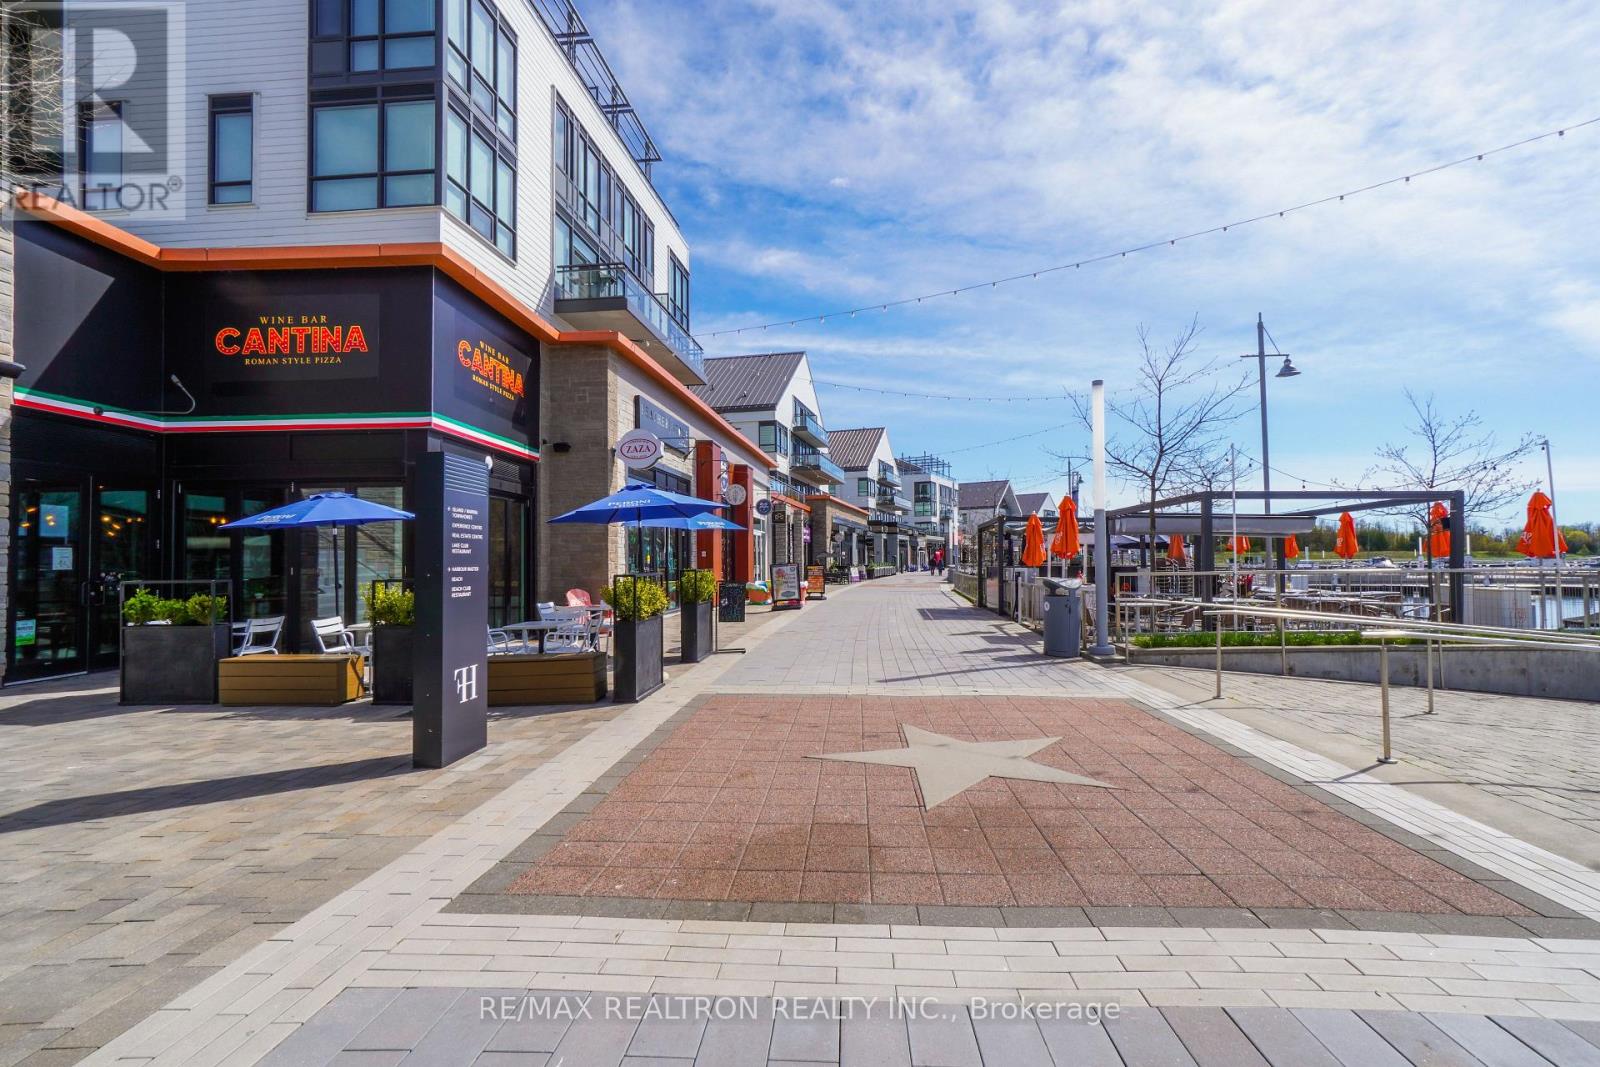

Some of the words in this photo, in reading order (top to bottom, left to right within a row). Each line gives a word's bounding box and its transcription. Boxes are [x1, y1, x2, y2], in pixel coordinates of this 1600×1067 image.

[259, 316, 294, 325] WINE
[301, 315, 328, 324] BAR
[215, 326, 368, 356] CANTINA
[245, 358, 279, 366] ROMAN
[282, 357, 312, 365] STYLE
[314, 356, 342, 364] PIZZA
[458, 339, 524, 398] CANTINA
[625, 444, 651, 454] ZAZA
